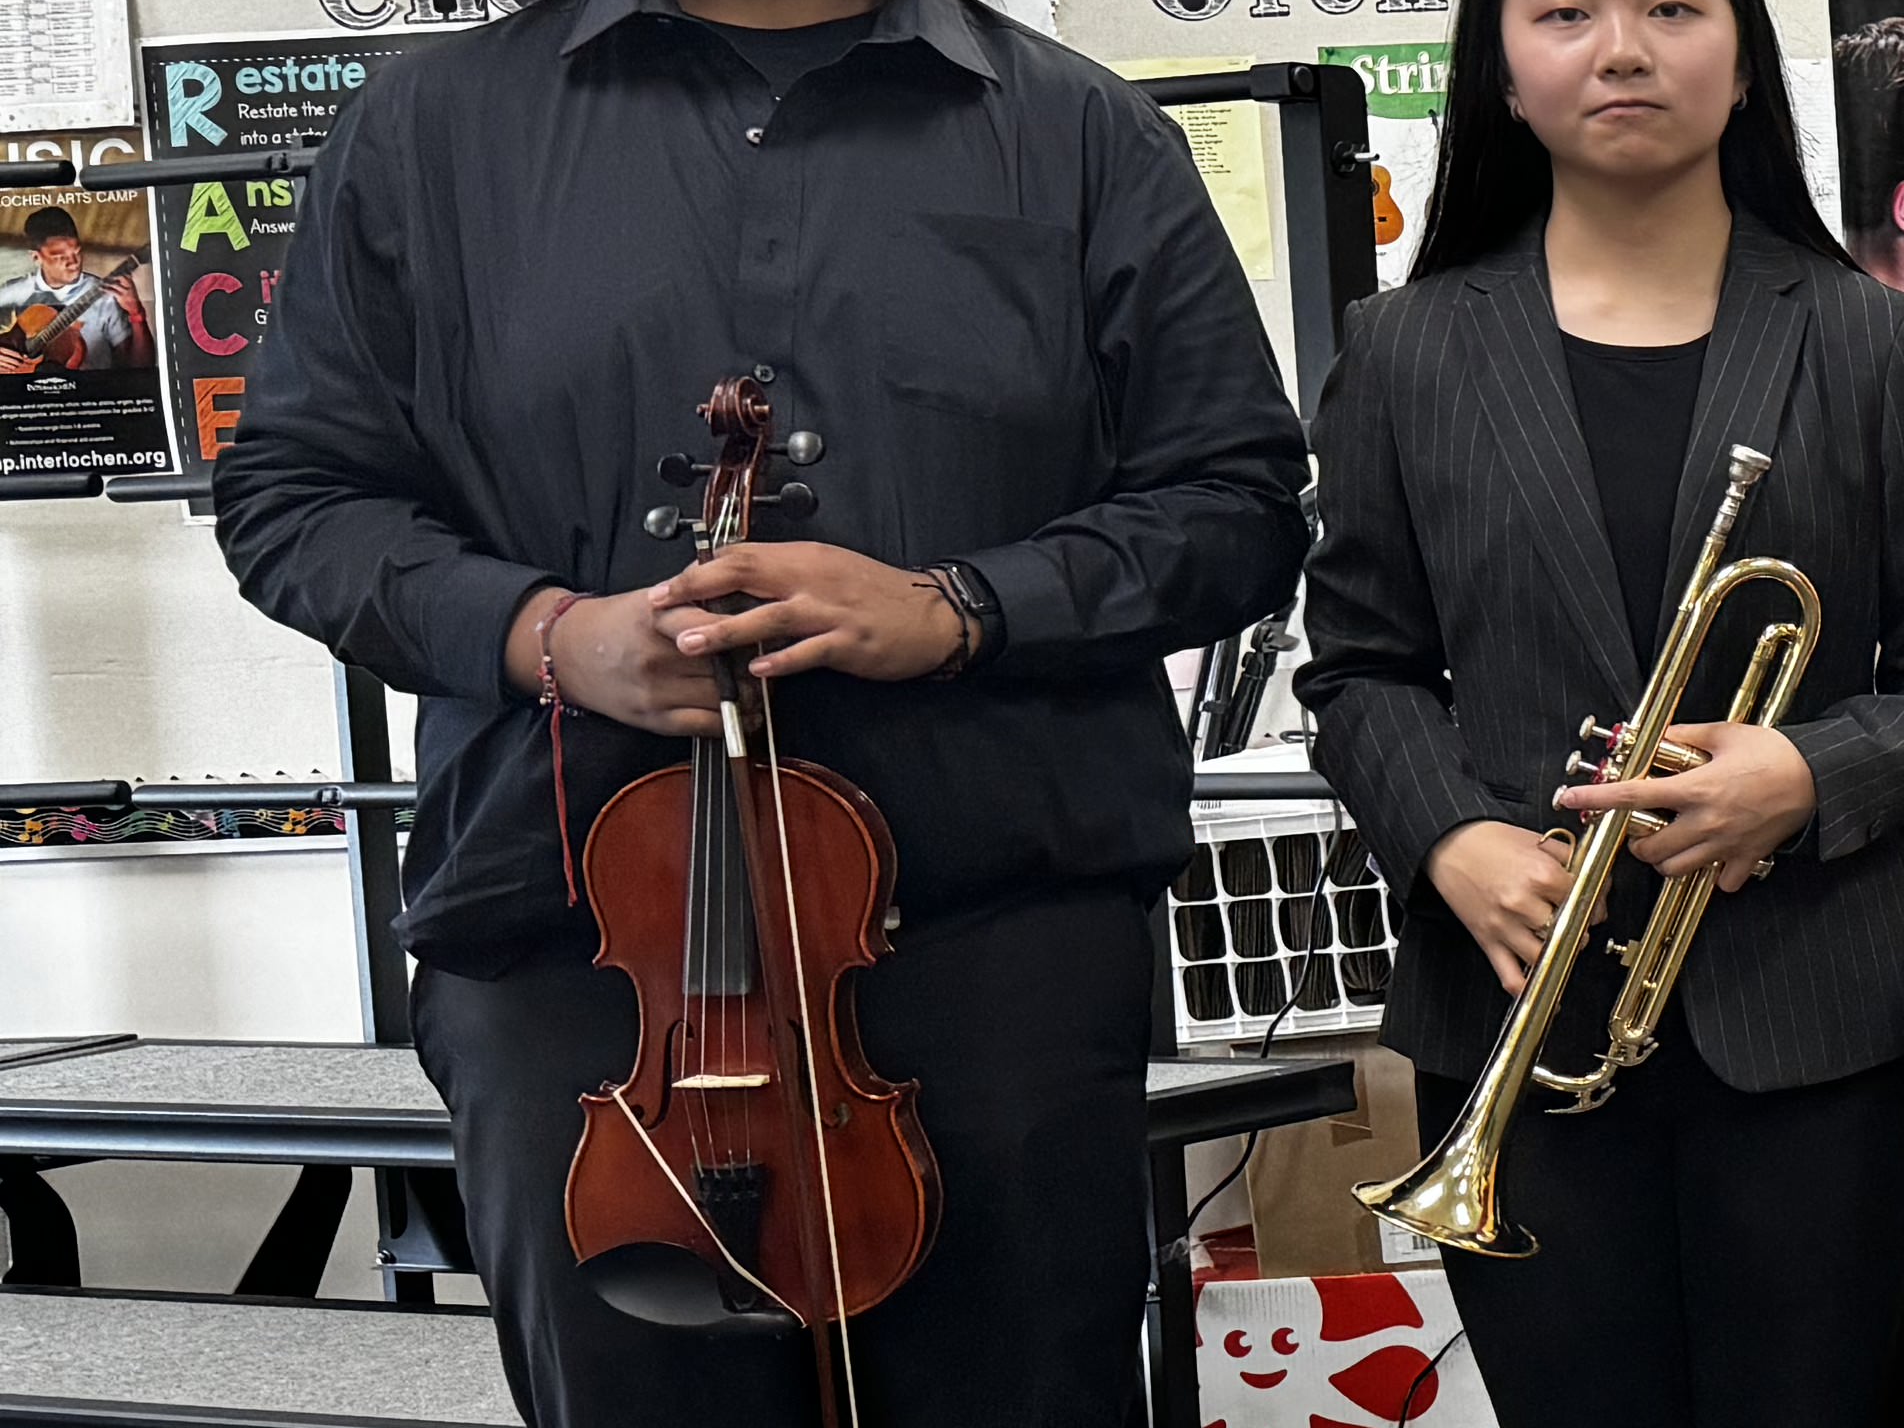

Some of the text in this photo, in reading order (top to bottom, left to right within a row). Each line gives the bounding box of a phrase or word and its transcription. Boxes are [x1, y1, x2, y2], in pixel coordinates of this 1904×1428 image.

[238, 103, 298, 119] Restate
[302, 101, 325, 116] the
[240, 131, 268, 145] into
[272, 134, 281, 144] a
[0, 190, 138, 207] OCHEN ARTS CAMP
[250, 219, 296, 234] Answe
